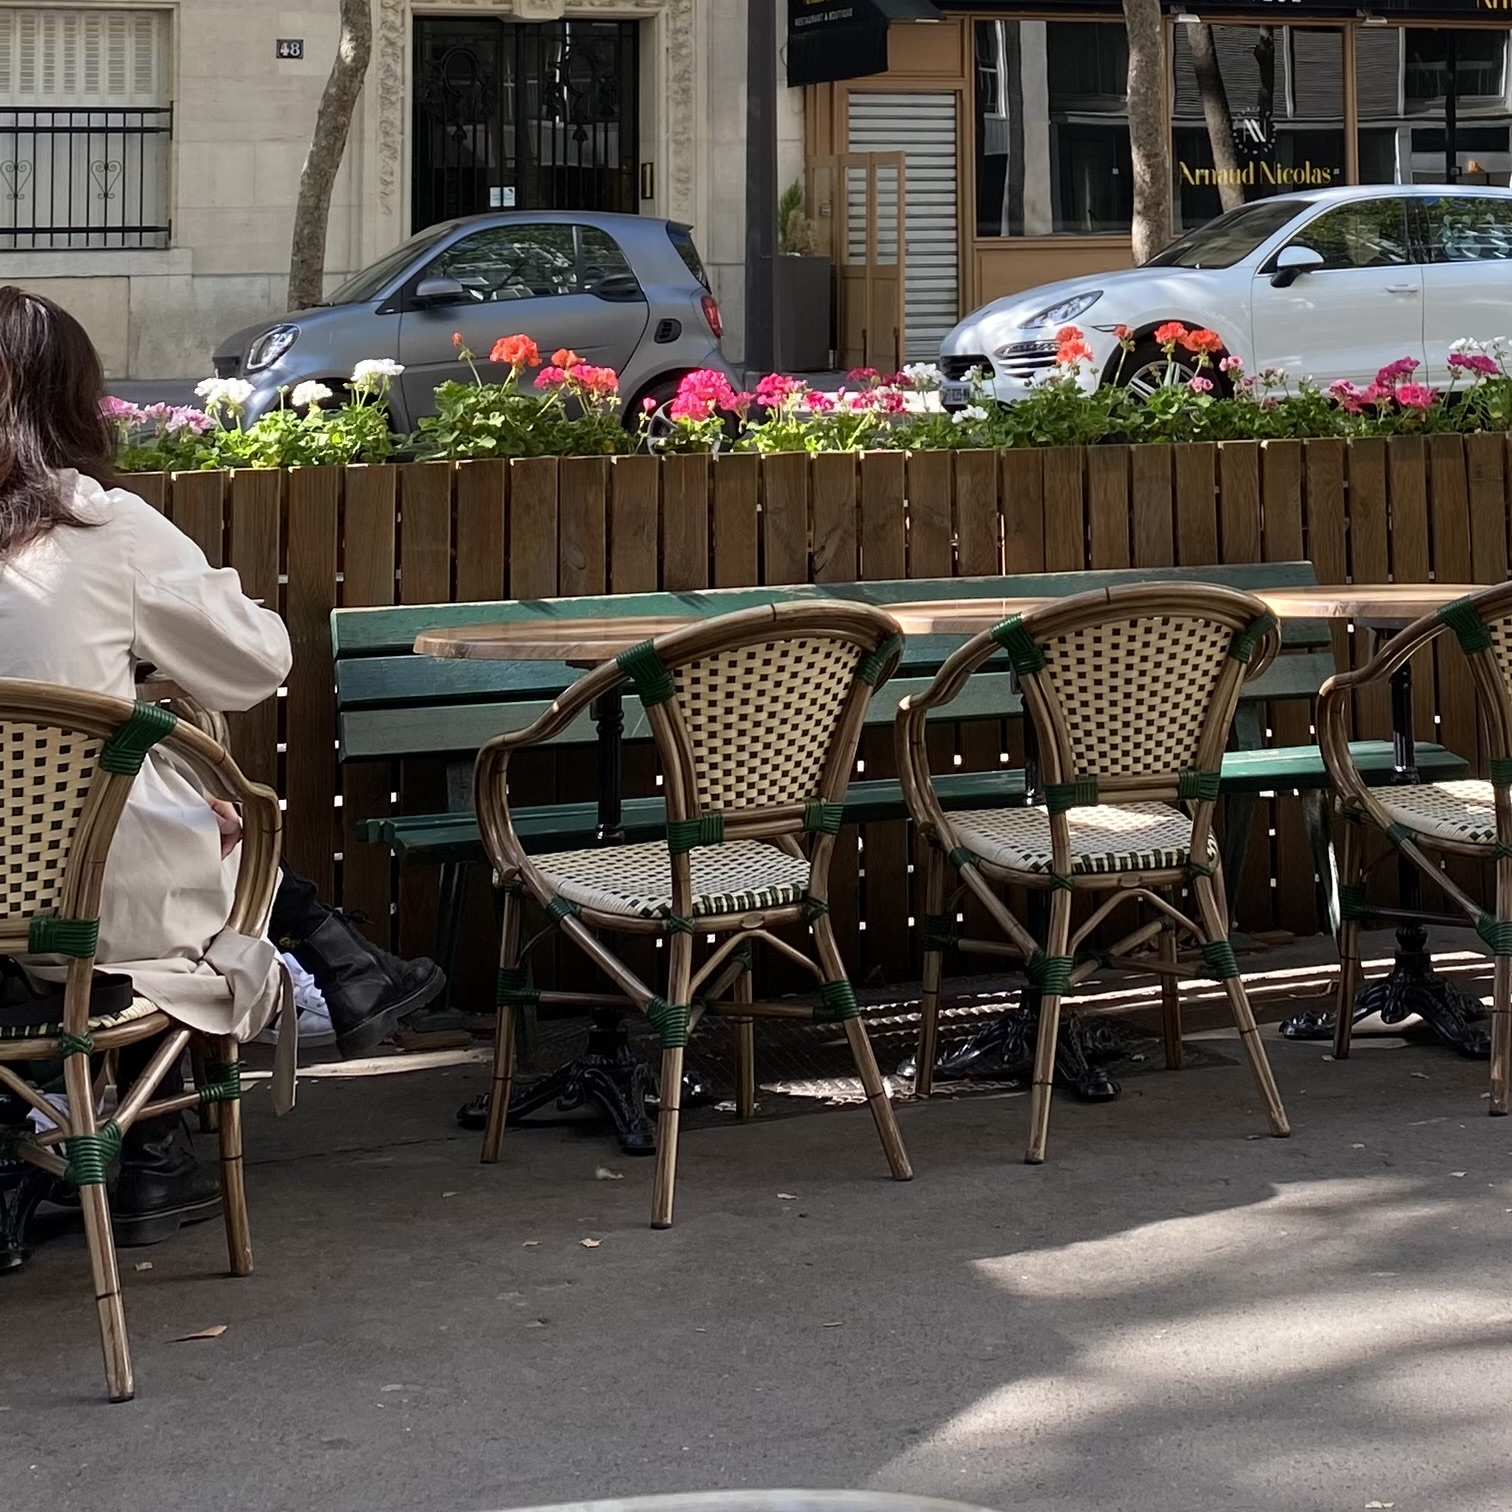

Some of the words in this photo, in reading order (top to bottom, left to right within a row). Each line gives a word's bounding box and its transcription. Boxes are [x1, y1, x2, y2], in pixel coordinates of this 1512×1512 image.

[280, 42, 301, 57] 48
[1179, 161, 1255, 185] Arnaud
[1260, 160, 1331, 185] Nicolas
